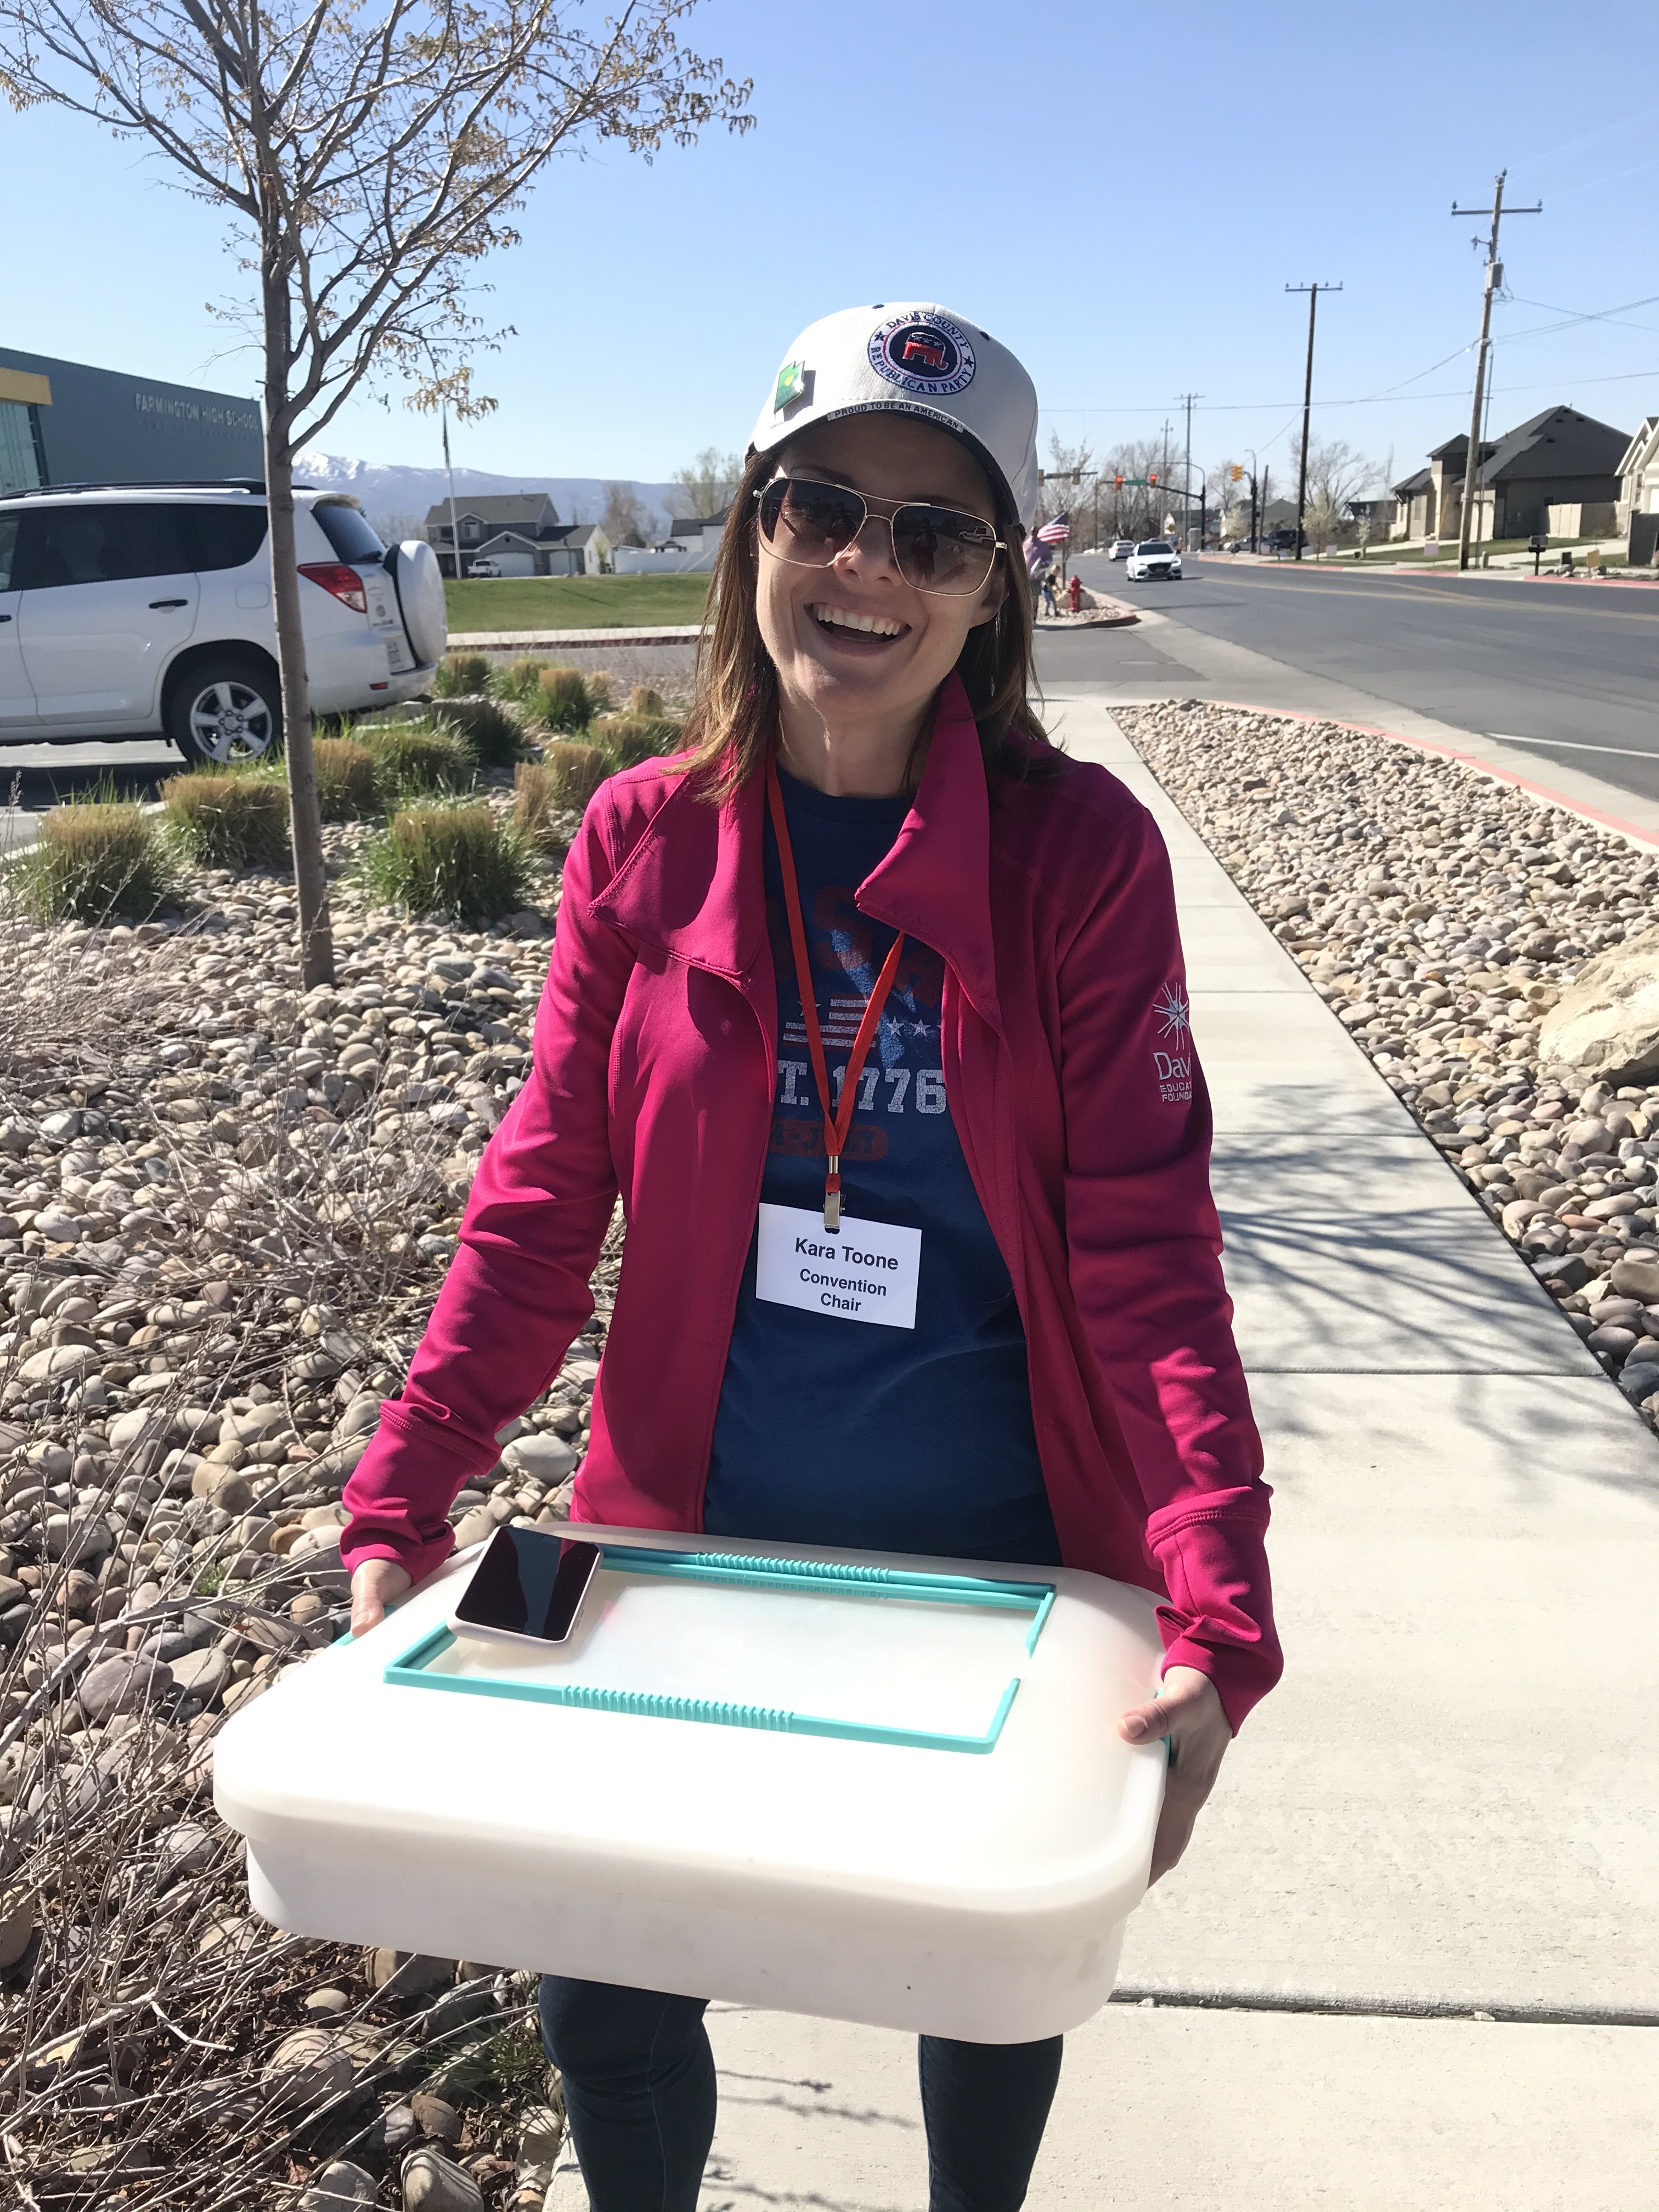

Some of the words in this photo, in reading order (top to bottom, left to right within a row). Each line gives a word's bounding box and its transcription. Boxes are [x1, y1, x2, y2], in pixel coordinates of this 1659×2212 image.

[887, 312, 921, 328] DAVIS
[924, 314, 969, 348] COUNTY
[871, 347, 937, 392] REPUBLICAN
[942, 368, 972, 392] PARTY
[136, 393, 199, 421] FARMINGTON
[202, 405, 224, 424] HIGH
[225, 410, 258, 430] SCHOOL
[834, 404, 867, 417] PROUD
[884, 402, 895, 410] BE
[898, 402, 911, 410] AN
[913, 405, 959, 430] AMERICAN
[1152, 1052, 1192, 1080] Dav
[832, 1065, 946, 1114] 1776
[795, 1237, 836, 1260] Kara
[842, 1246, 899, 1270] Toone
[799, 1268, 887, 1296] Convention
[820, 1293, 862, 1312] Chair
